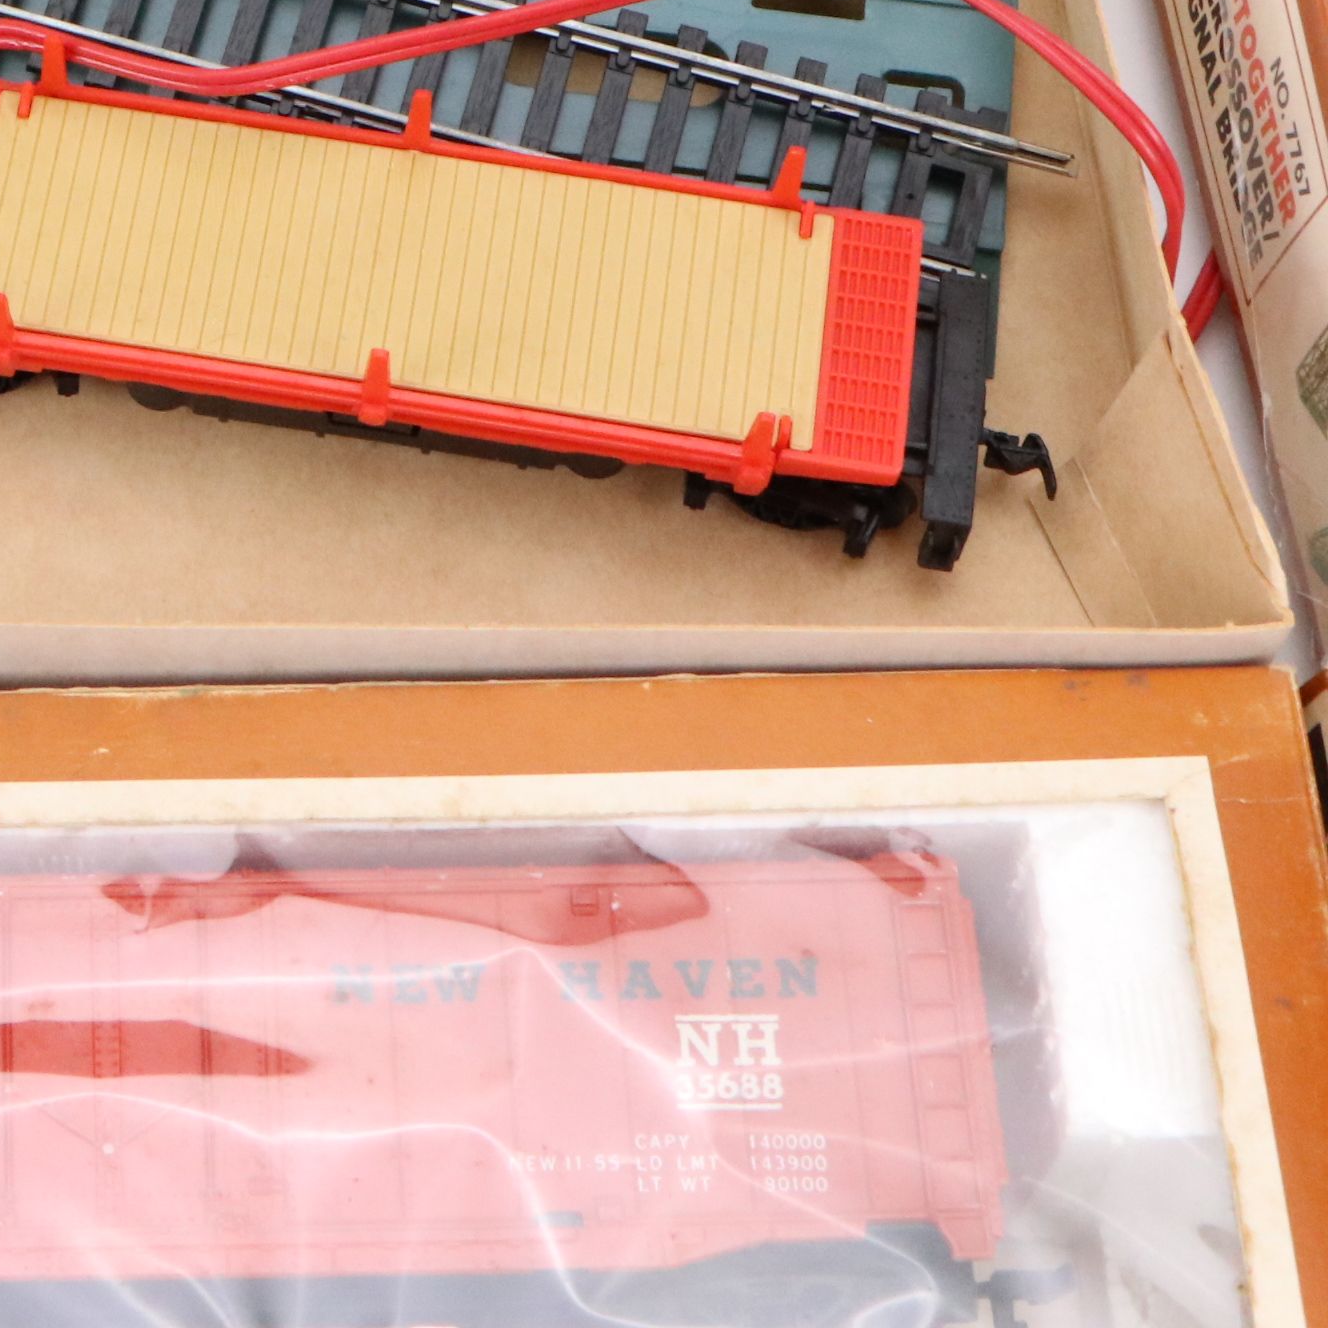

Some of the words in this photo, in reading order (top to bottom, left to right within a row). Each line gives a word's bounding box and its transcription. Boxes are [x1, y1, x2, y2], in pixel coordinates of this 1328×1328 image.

[1270, 56, 1290, 120] NO.
[1285, 120, 1311, 196] 7767
[330, 963, 486, 1004] NEW
[558, 957, 820, 1002] HAVEN
[675, 1023, 783, 1067] NH
[634, 1134, 690, 1150] CAPY
[676, 1154, 719, 1171] LMT
[637, 1175, 662, 1192] LT
[680, 1175, 712, 1192] WT
